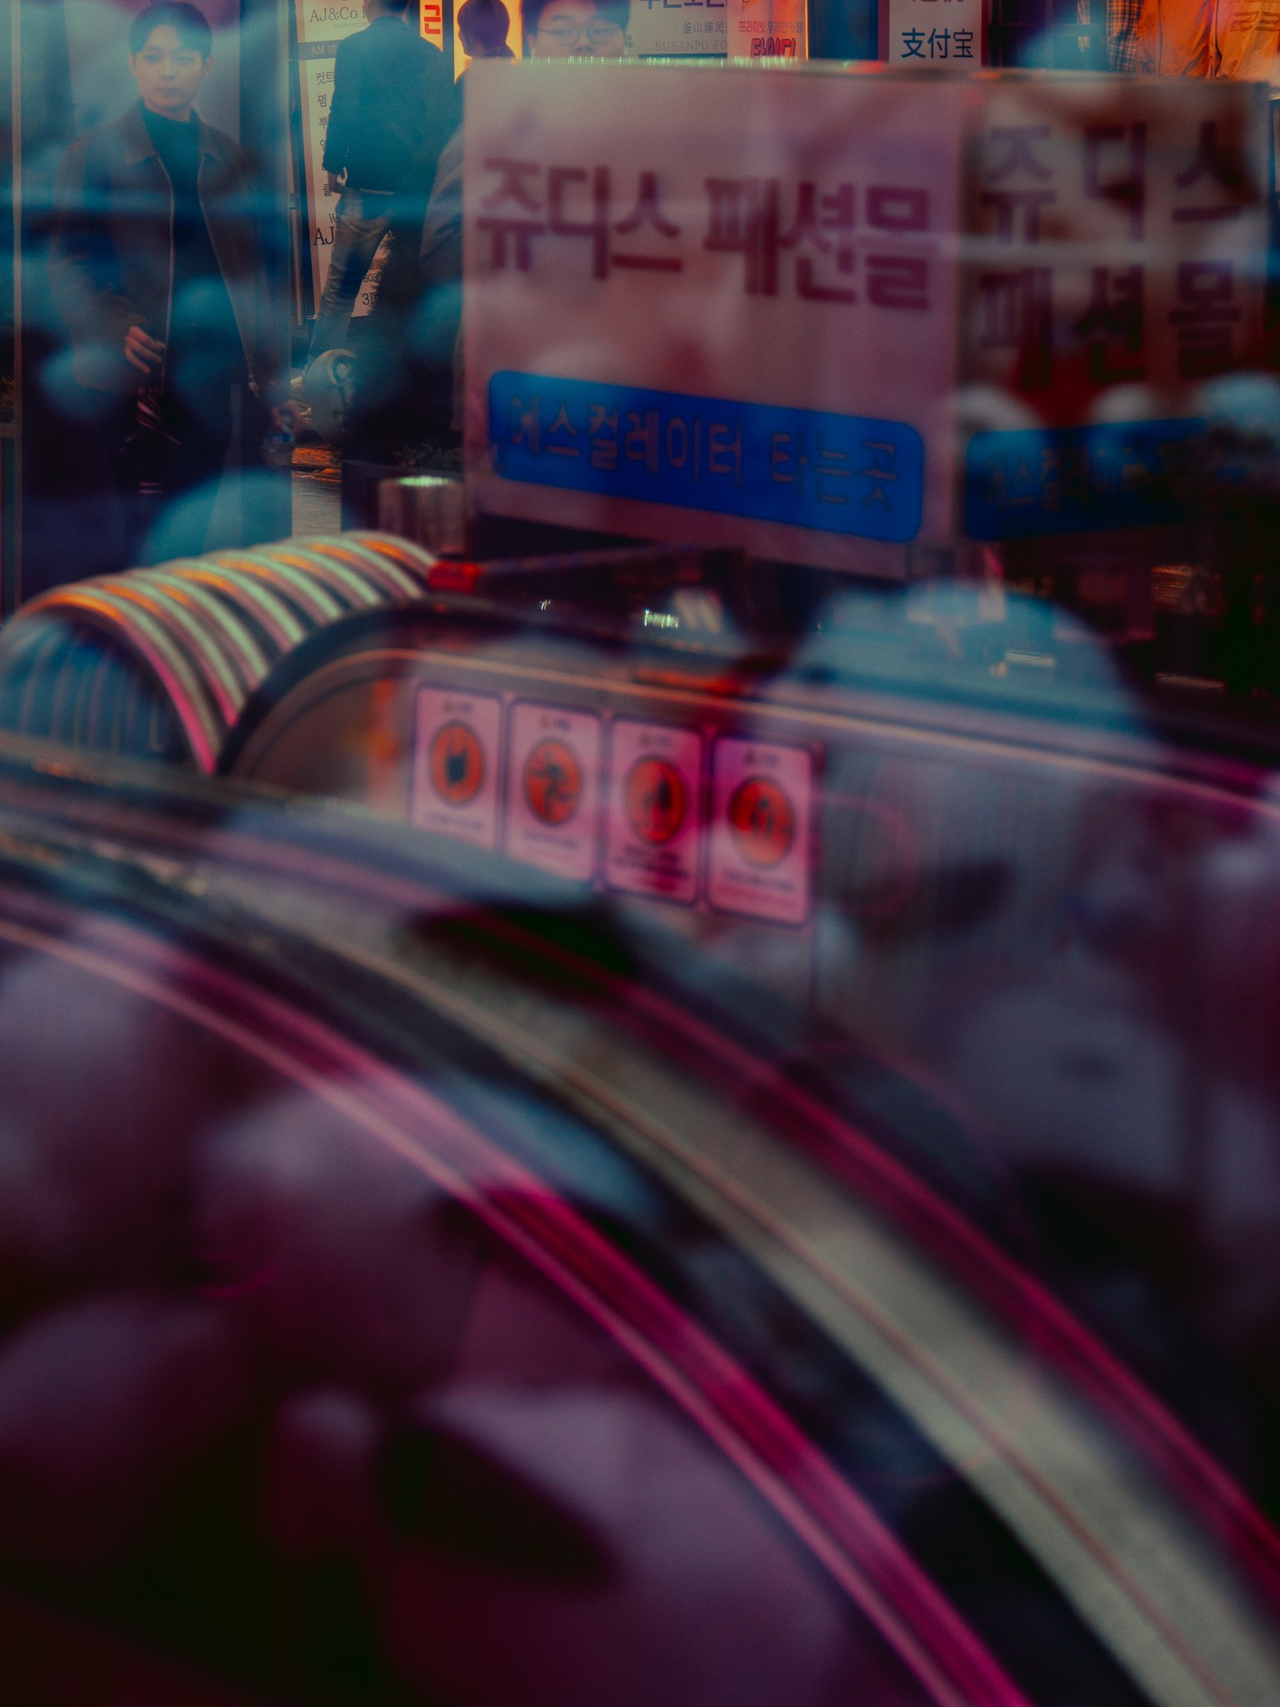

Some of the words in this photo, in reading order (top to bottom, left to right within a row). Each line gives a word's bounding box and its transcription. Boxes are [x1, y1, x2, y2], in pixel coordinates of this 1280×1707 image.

[310, 6, 358, 23] AJ&Co
[655, 41, 709, 52] BUSANPO
[901, 28, 974, 59] 支付宝
[476, 156, 684, 281] 쥬디스
[704, 175, 931, 311] 패션몰
